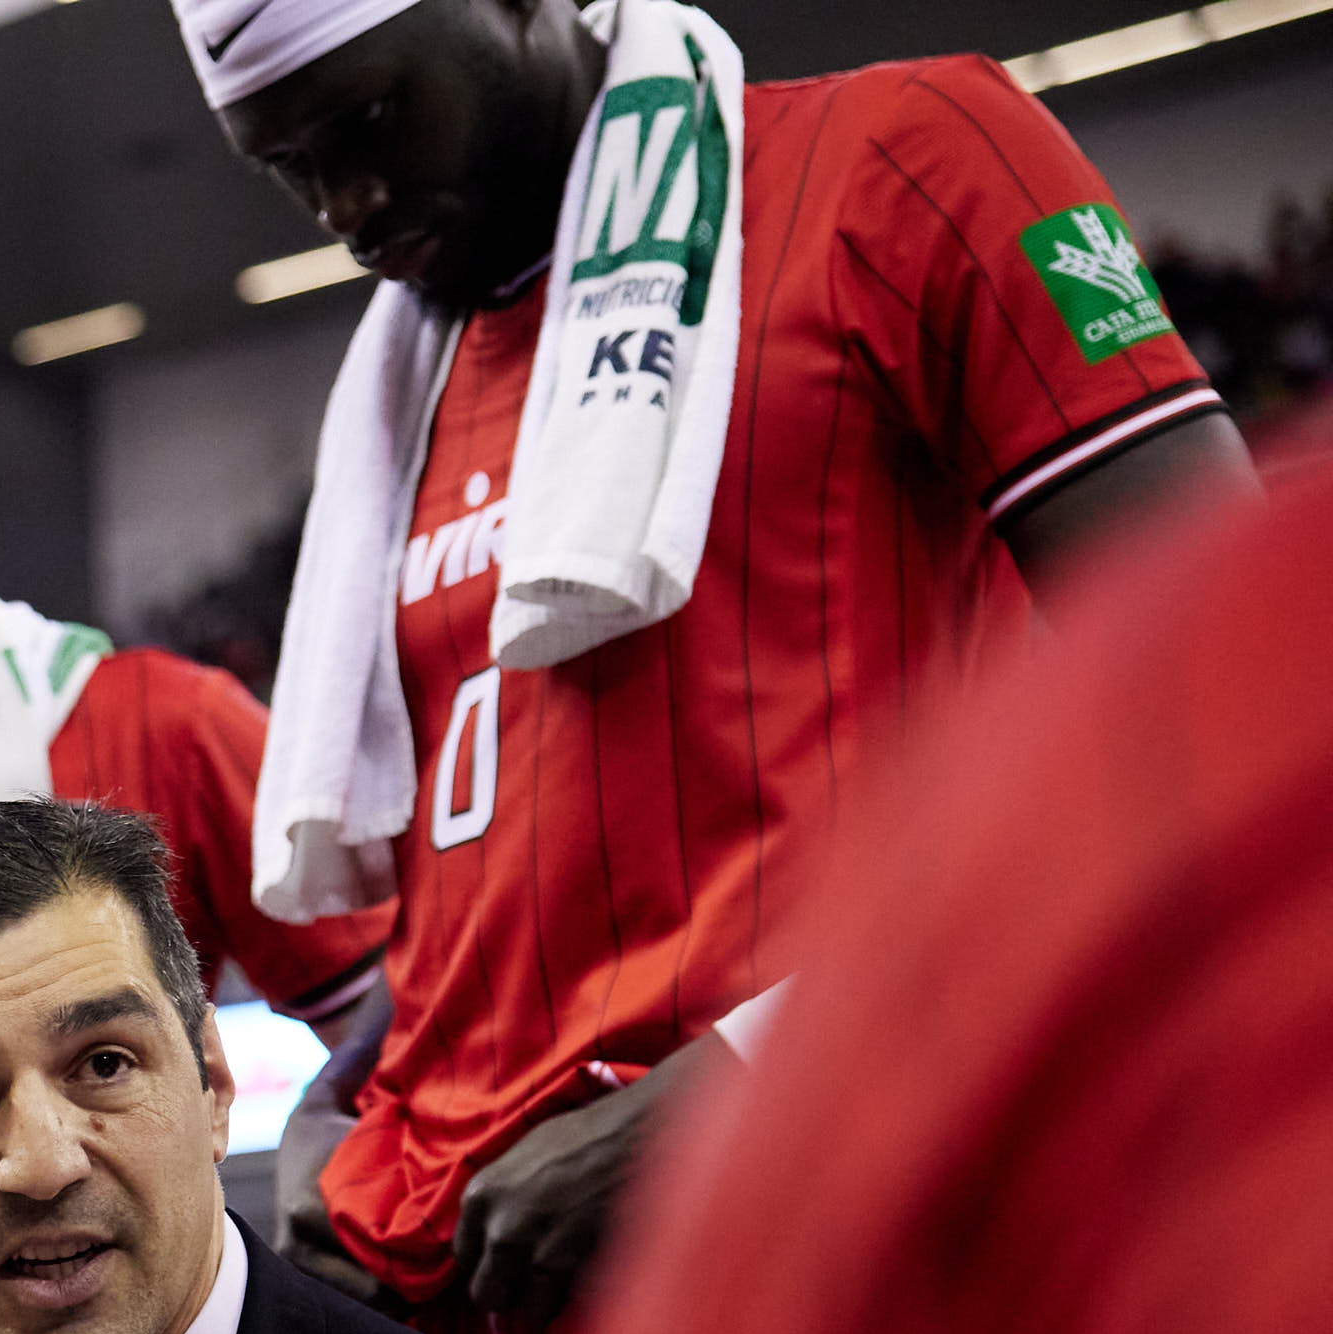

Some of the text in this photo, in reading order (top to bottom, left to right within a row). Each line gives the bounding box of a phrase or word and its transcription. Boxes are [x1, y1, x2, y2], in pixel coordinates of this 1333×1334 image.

[579, 386, 667, 412] PHA
[588, 328, 675, 383] KE
[401, 471, 513, 606] VIR
[432, 664, 502, 852] 0
